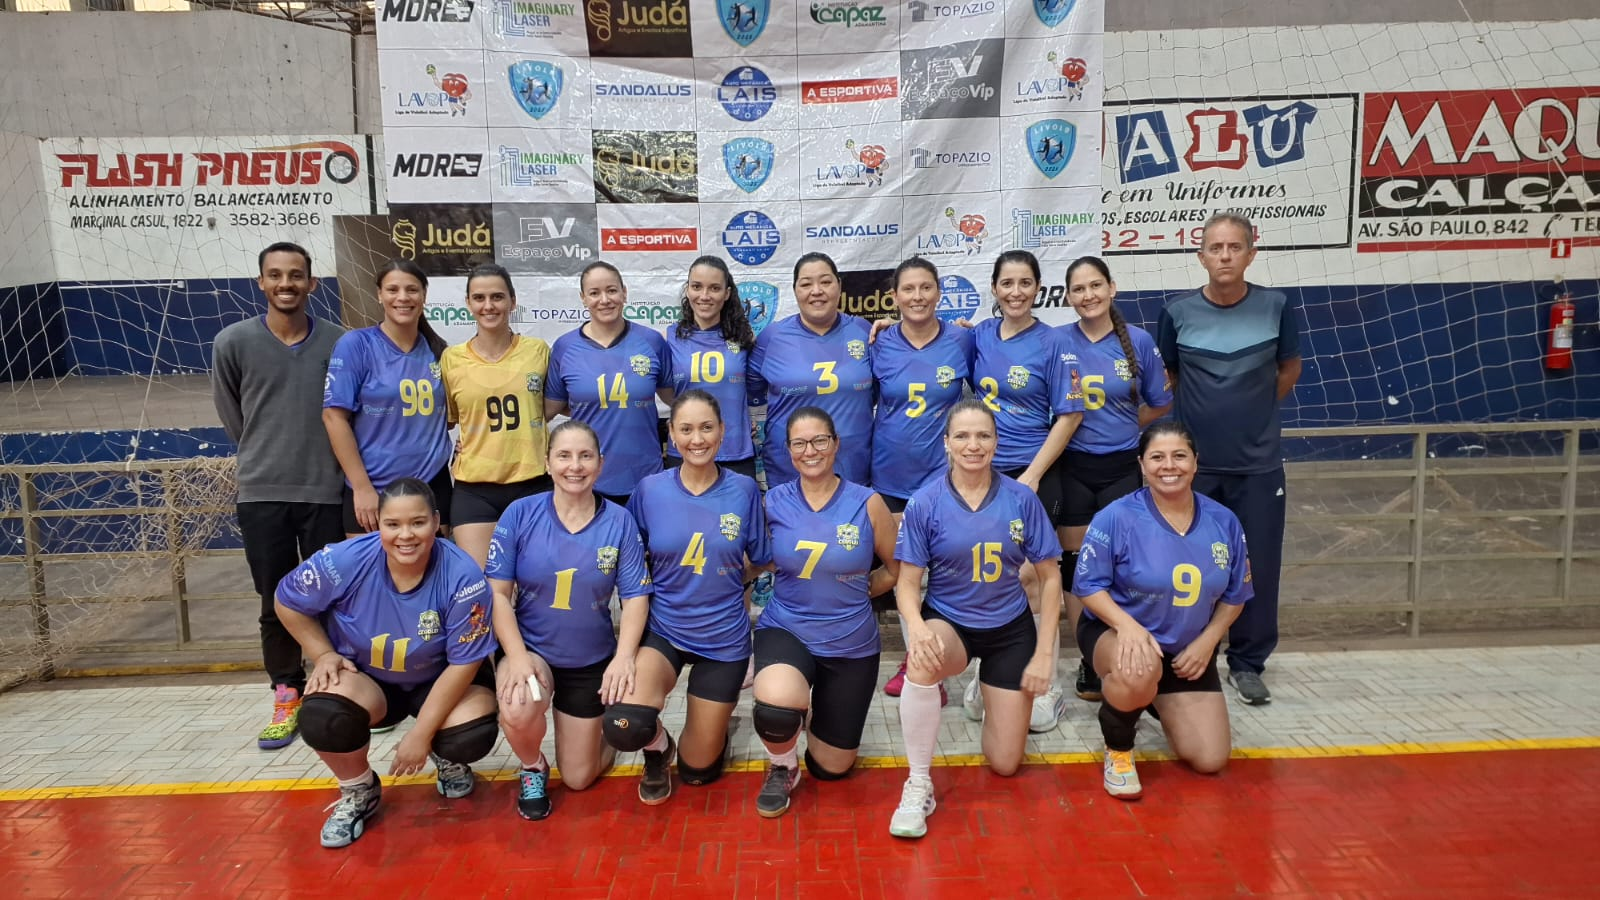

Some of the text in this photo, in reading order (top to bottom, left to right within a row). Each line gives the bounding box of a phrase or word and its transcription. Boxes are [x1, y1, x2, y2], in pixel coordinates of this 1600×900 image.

[513, 1, 576, 16] IMAGINARY
[933, 1, 995, 17] TOPAZIO
[514, 14, 551, 27] LASER
[595, 84, 692, 96] SANDALUS
[717, 87, 777, 102] LAIS
[807, 84, 892, 97] A ESPORTIVA
[521, 152, 584, 164] IMAGINARY
[935, 152, 991, 164] TOPAZIO
[56, 152, 322, 188] FLASH PNEUS
[521, 164, 557, 176] LASER
[69, 192, 333, 208] ALINHAMENTO BALANCEAMENTO
[1119, 188, 1154, 203] em
[1165, 180, 1287, 204] Uniformes
[70, 215, 127, 229] MARGINAL
[173, 214, 203, 227] 1822
[229, 213, 321, 226] 3582-3686
[1032, 213, 1095, 226] IMAGINARY
[1358, 222, 1383, 238] AV.
[1387, 217, 1423, 238] SÃO
[1493, 219, 1529, 235] 842
[421, 222, 491, 247] Judá
[607, 234, 692, 245] A ESPORTIVA
[722, 230, 781, 246] LAIS
[806, 224, 899, 238] SANDALUS
[1032, 225, 1066, 237] LASER
[936, 293, 981, 309] AIS
[690, 350, 725, 383] 10
[812, 361, 839, 395] 3
[400, 378, 435, 417] 98
[596, 372, 629, 409] 14
[905, 383, 927, 418] 5
[979, 376, 1001, 412] 2
[1081, 375, 1106, 411] 6
[486, 394, 521, 432] 99
[680, 532, 708, 575] 4
[794, 539, 828, 580] 7
[971, 542, 1003, 583] 15
[549, 567, 579, 610] 1
[1171, 563, 1202, 607] 9
[369, 633, 412, 673] 11
